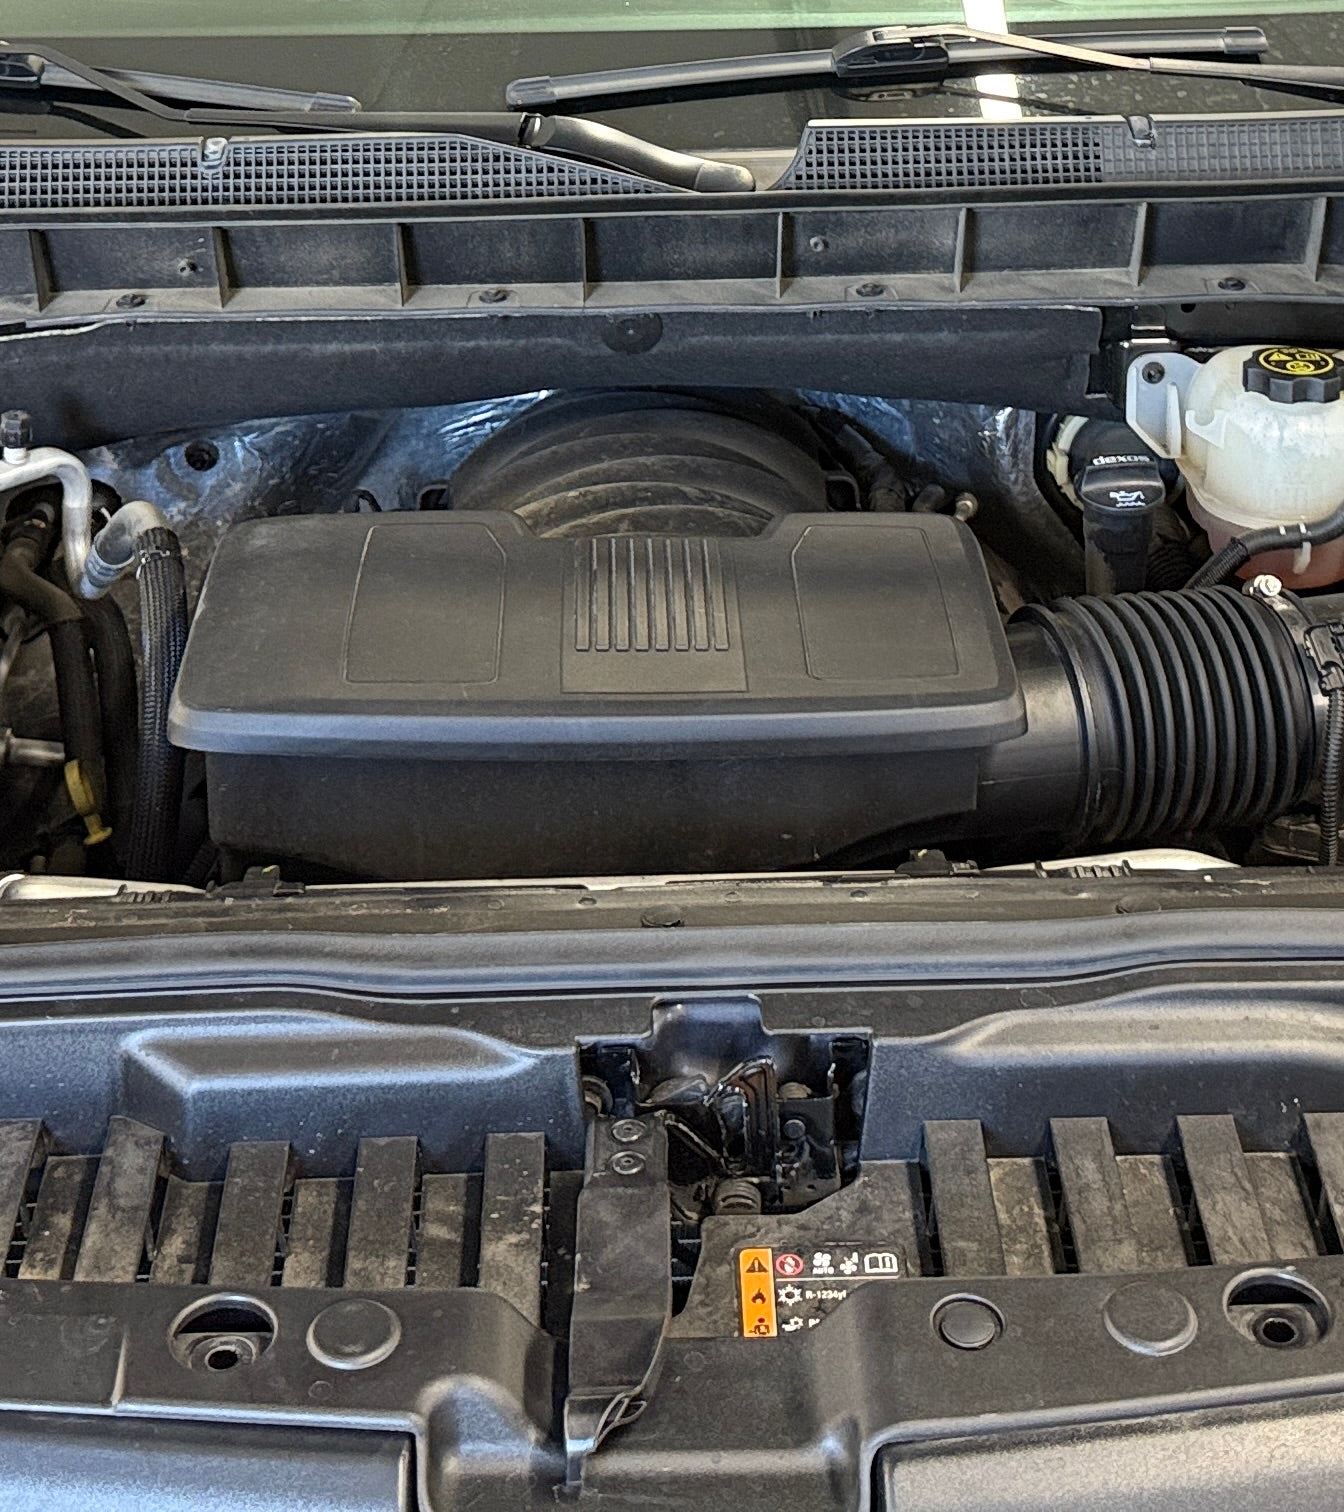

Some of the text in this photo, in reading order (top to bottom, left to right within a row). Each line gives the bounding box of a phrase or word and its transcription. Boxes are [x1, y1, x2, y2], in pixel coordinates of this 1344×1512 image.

[1092, 455, 1150, 466] dexos
[812, 1266, 835, 1275] AUTO
[805, 1289, 847, 1301] R-1234yf
